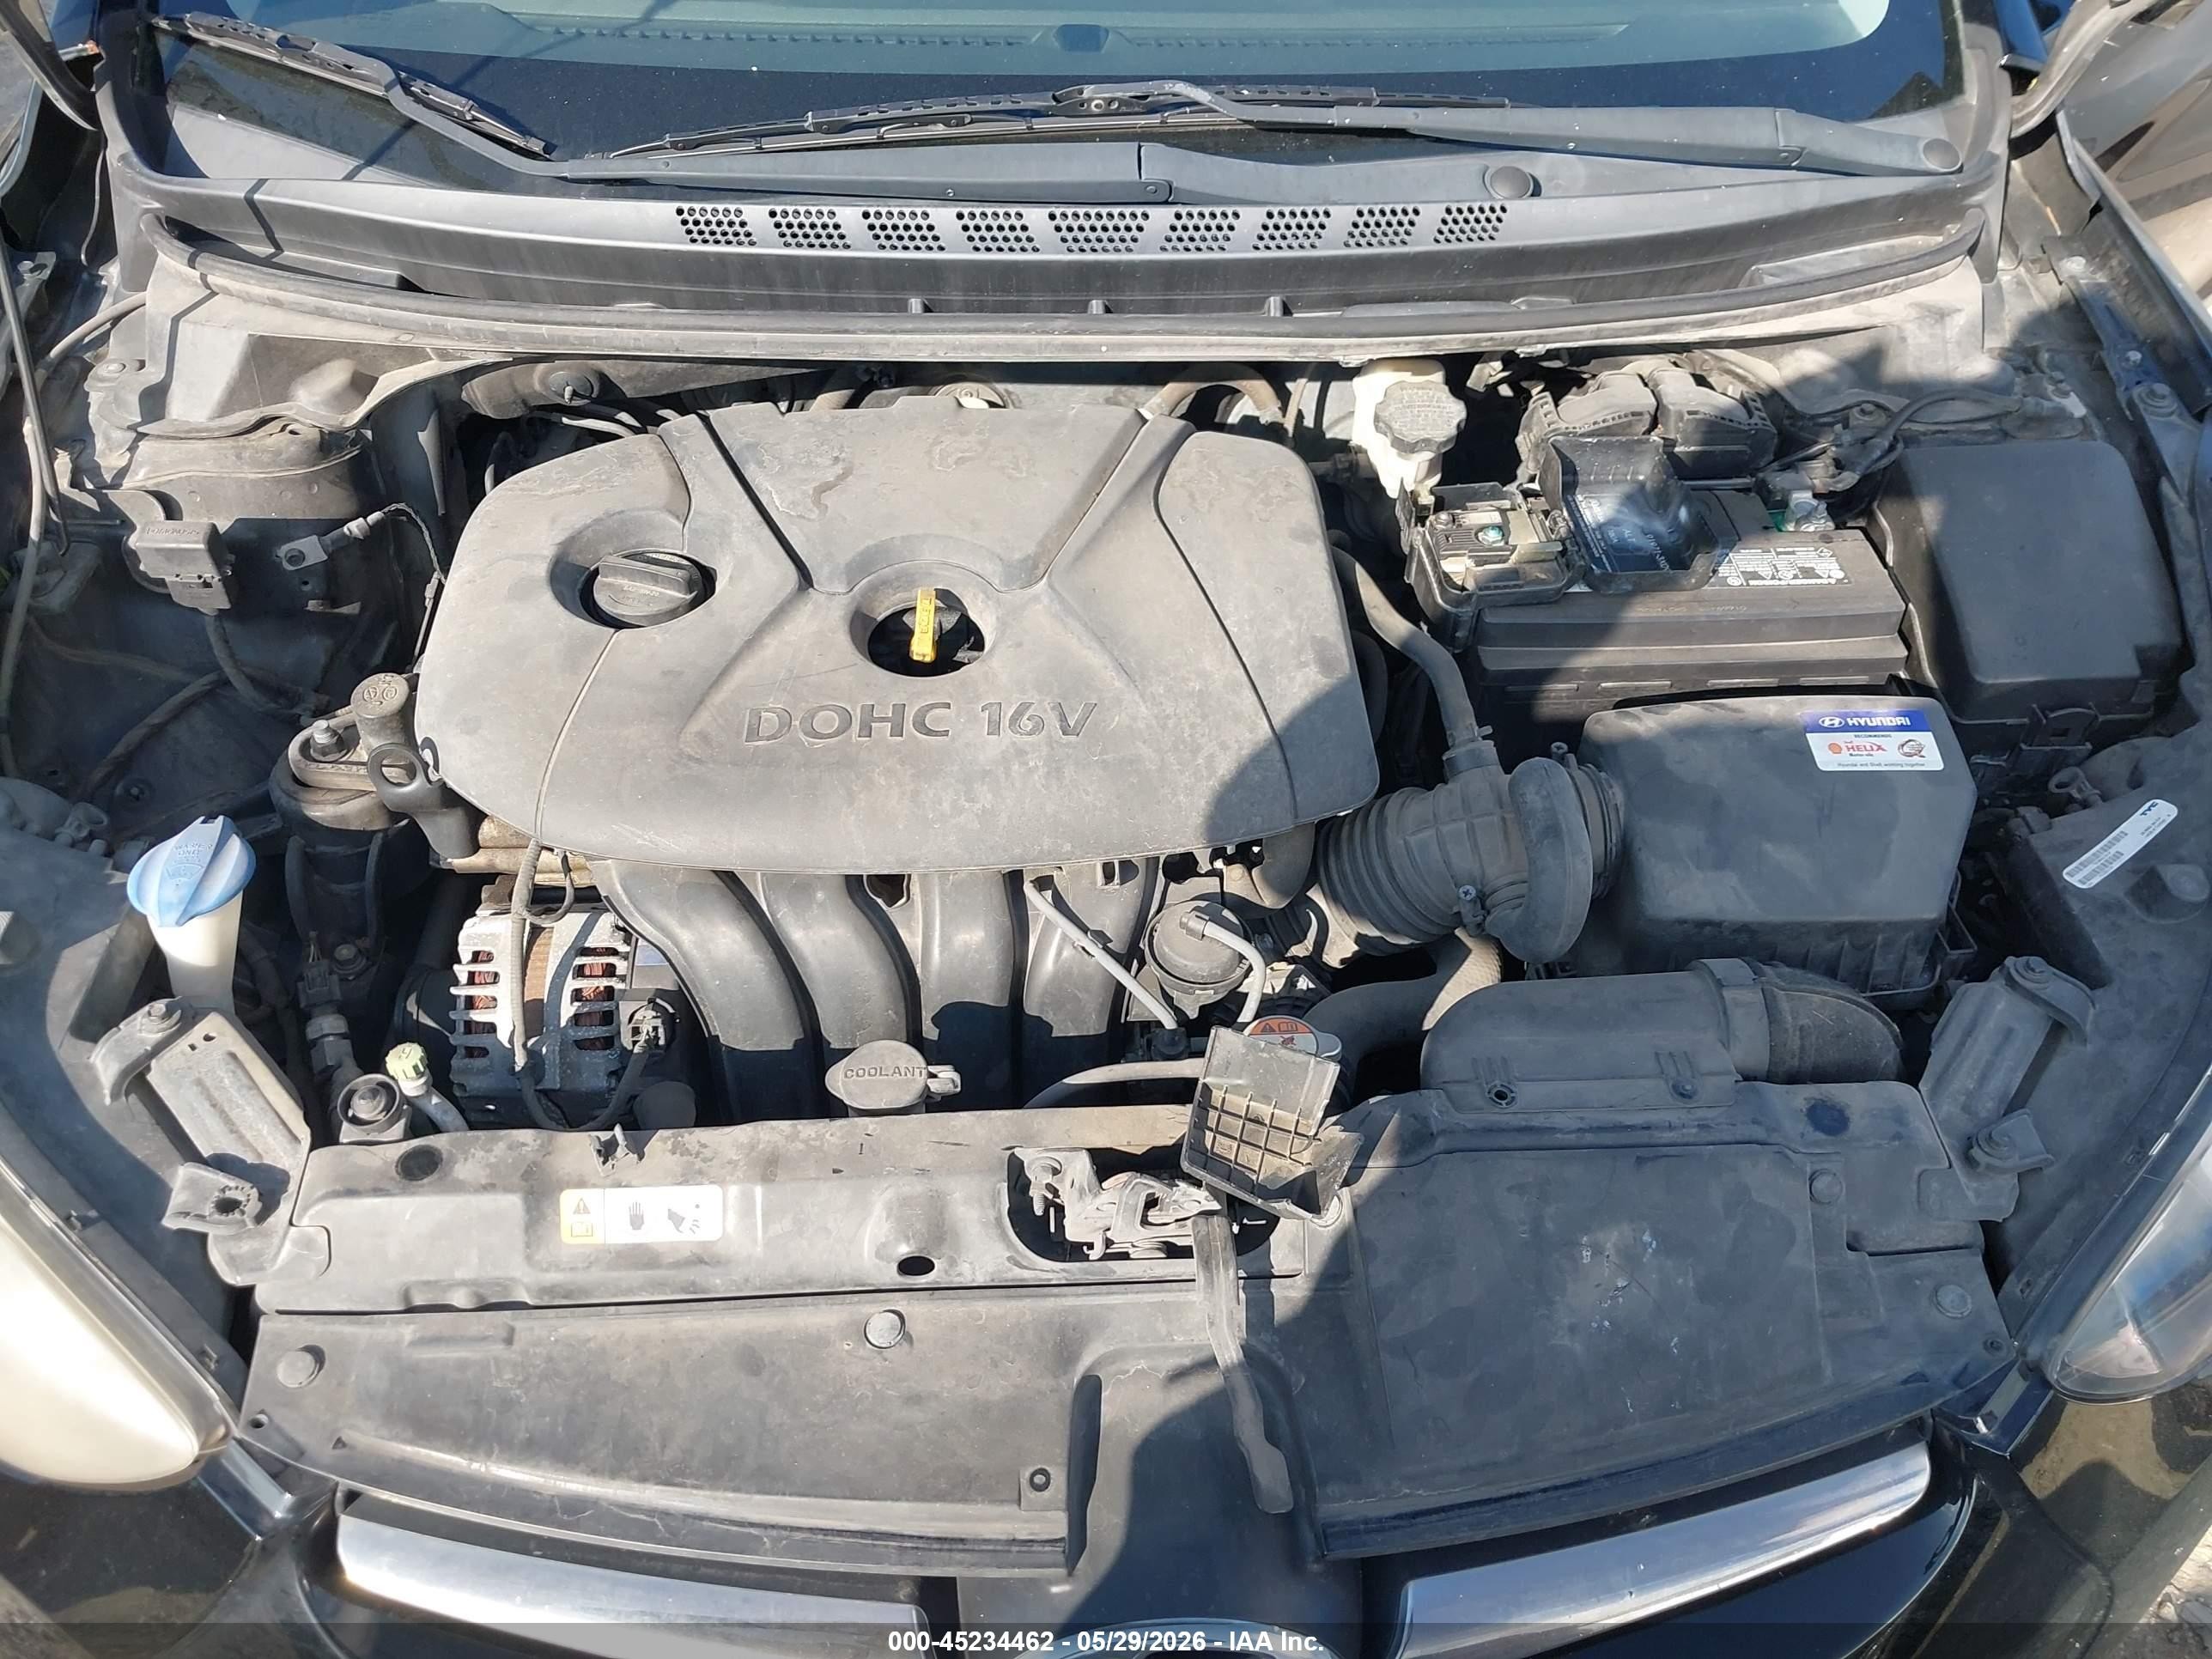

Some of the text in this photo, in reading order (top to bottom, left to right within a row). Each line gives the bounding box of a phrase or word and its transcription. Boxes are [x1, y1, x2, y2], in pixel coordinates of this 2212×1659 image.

[744, 701, 1097, 744] DOHC 16V
[1847, 716, 1911, 726] HYUNDAI
[2140, 801, 2159, 817] TYC
[843, 1066, 927, 1079] COOLANT
